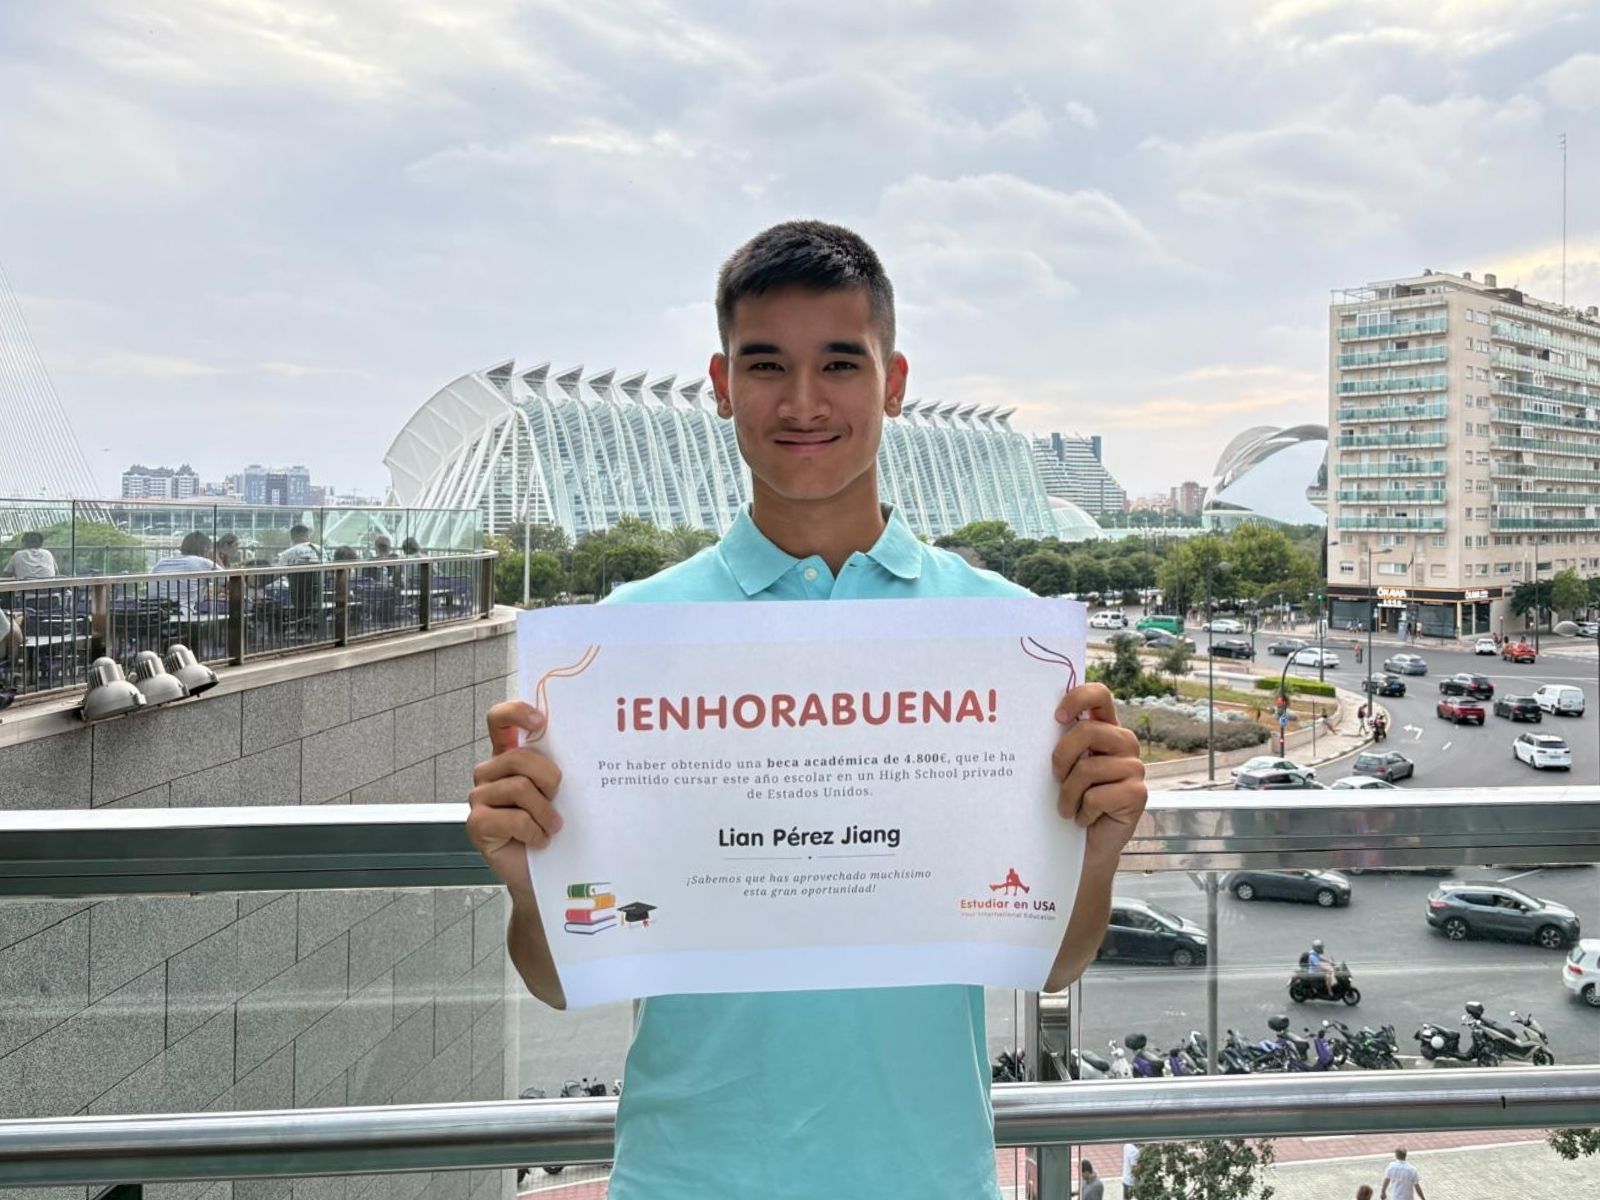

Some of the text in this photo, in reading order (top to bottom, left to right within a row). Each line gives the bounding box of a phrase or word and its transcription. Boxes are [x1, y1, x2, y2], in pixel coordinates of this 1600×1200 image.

[616, 689, 997, 733] ¡ENHORABUENA!
[599, 760, 621, 770] Por
[627, 760, 666, 770] haber
[671, 759, 731, 769] obtenido
[737, 760, 761, 769] una
[767, 758, 798, 768] beca
[804, 755, 878, 767] académica
[884, 754, 899, 764] de
[956, 754, 979, 764] que
[984, 752, 995, 762] le
[1000, 751, 1015, 762] ha
[601, 767, 1013, 787] permitido cursar este año escolar en un High School privado
[747, 785, 872, 799] de Estados Unidos.
[719, 825, 900, 848] Lian Pérez Jiang
[687, 874, 741, 887] ¡Sabemos
[745, 874, 765, 885] que
[769, 872, 788, 883] has
[793, 870, 866, 884] aprovechado
[743, 884, 876, 897] esta gran oportunidad!
[960, 898, 1055, 912] Estudiar en USA
